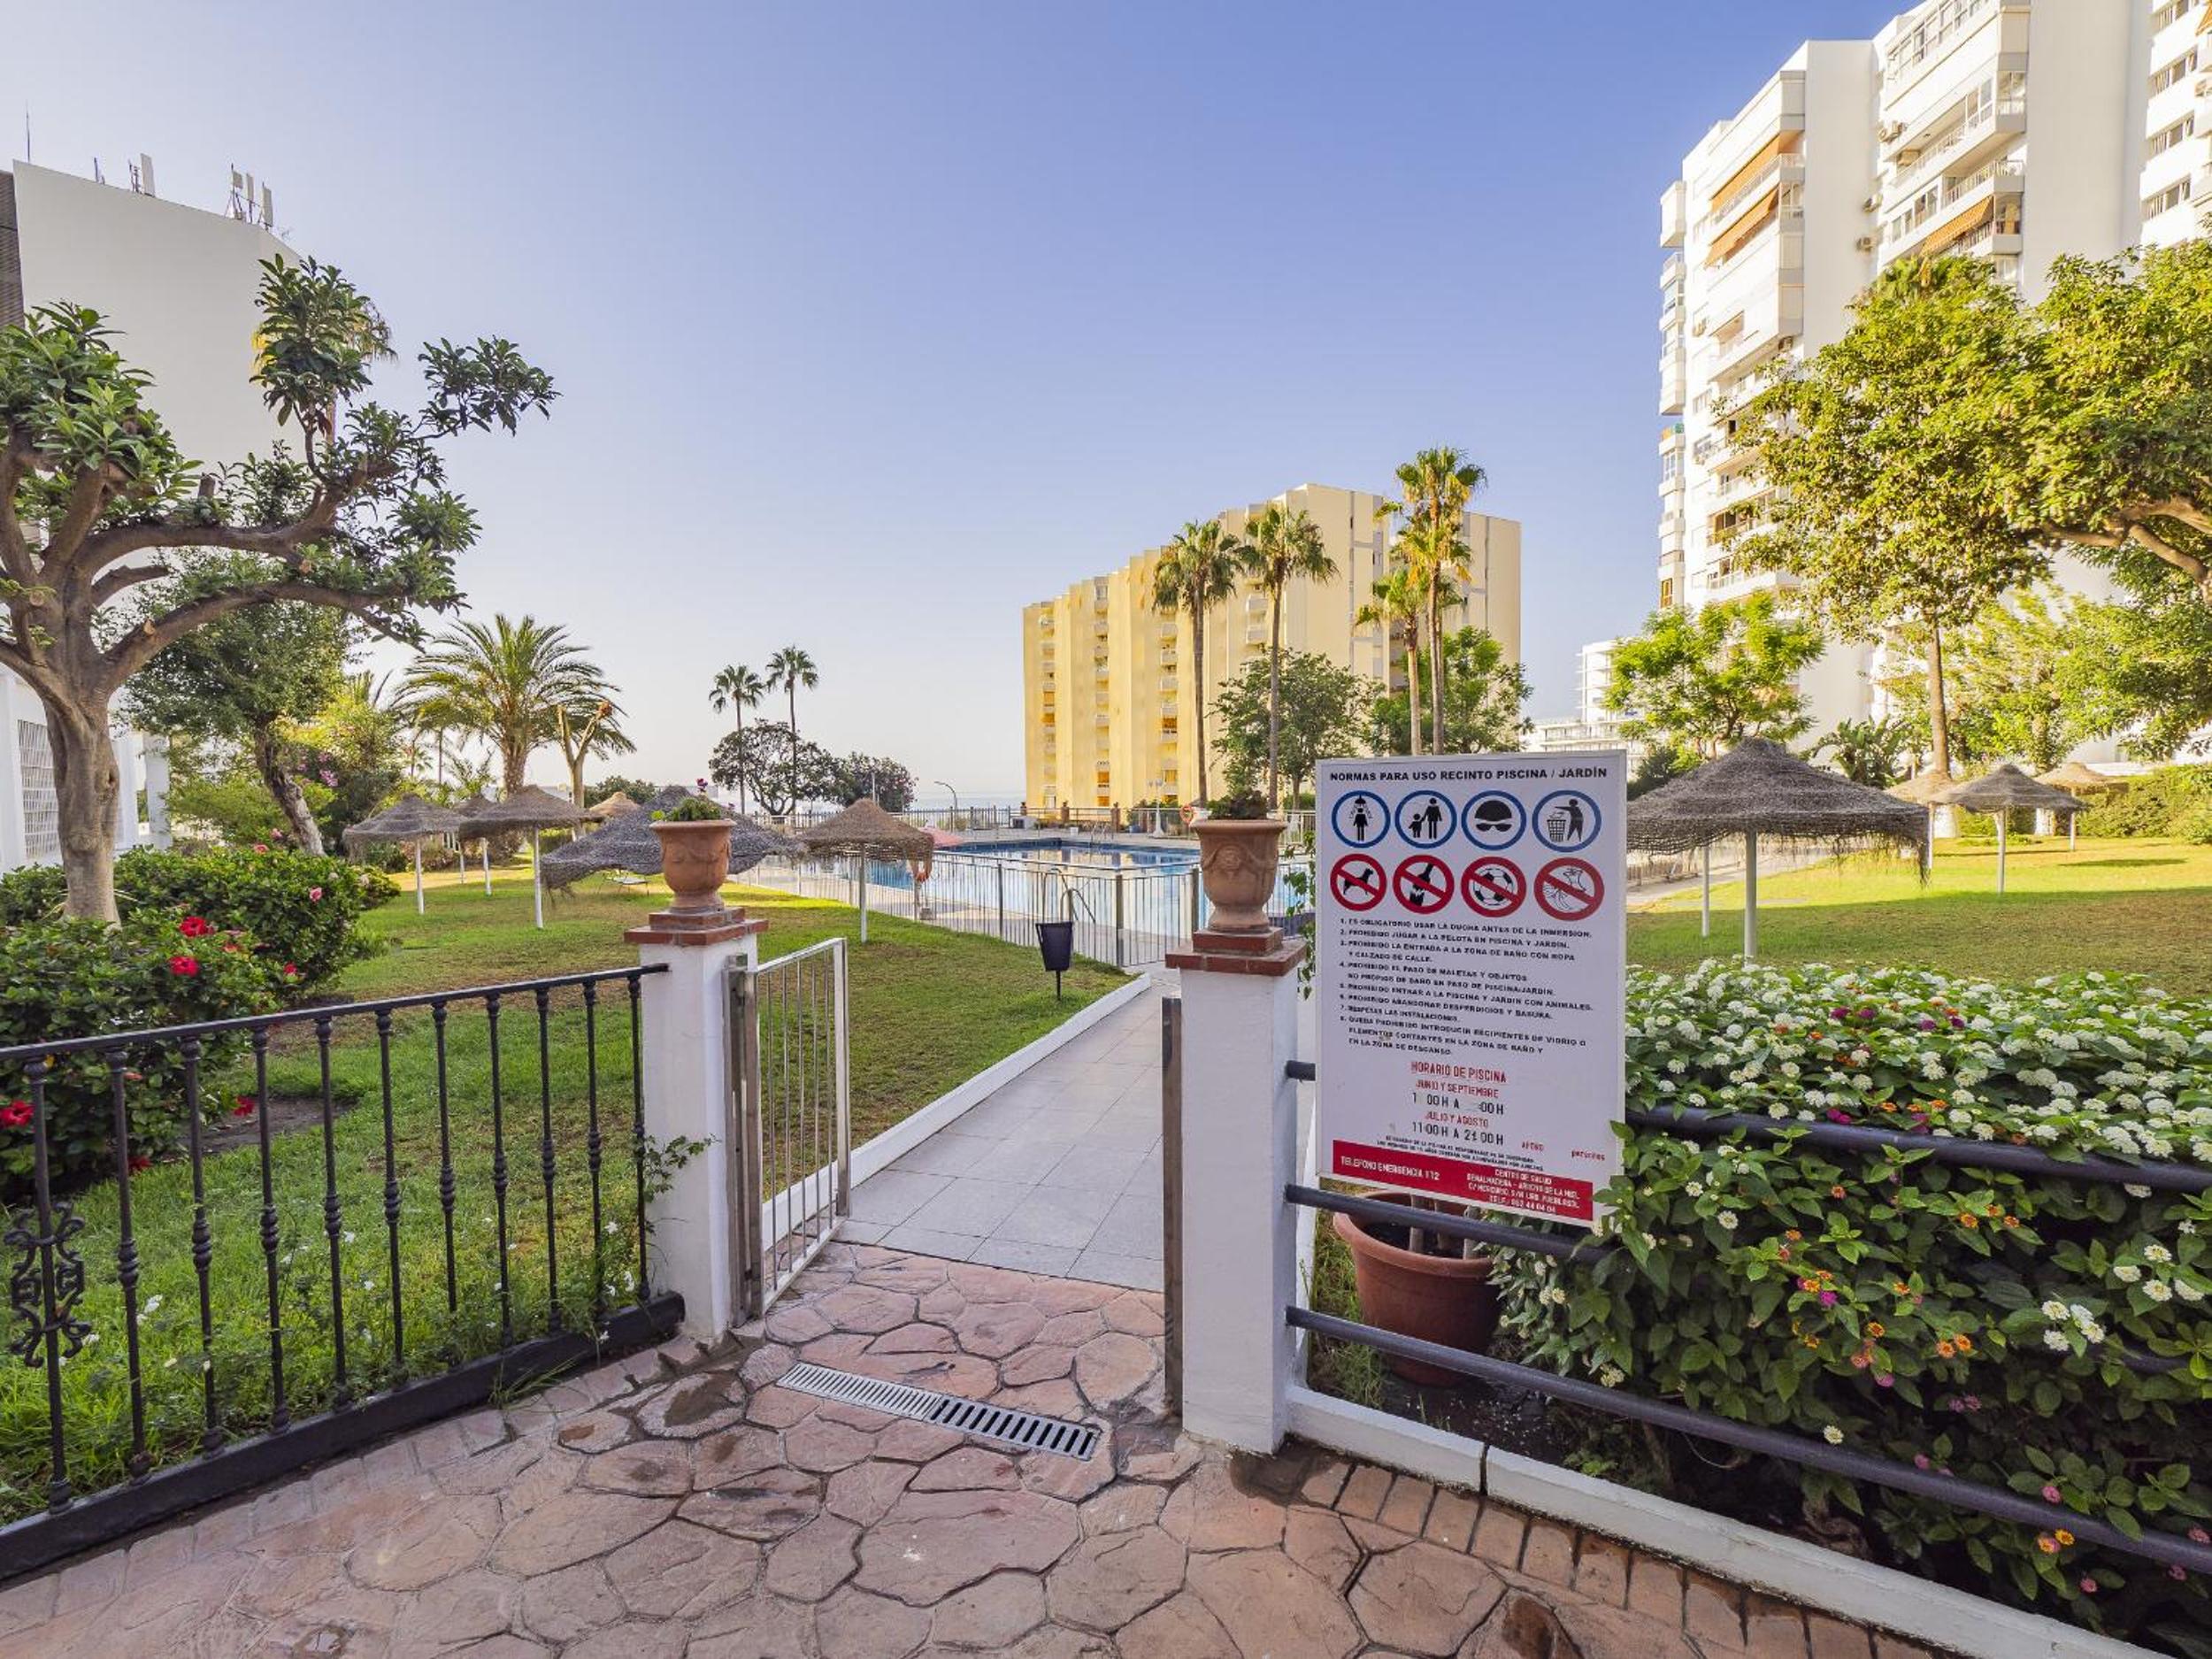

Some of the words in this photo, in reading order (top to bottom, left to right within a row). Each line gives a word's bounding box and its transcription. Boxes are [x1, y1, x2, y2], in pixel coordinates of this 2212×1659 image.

[1413, 771, 1437, 780] USO
[1440, 771, 1493, 780] RECINTO
[1496, 769, 1548, 780] PISCINA
[1559, 766, 1607, 778] JARDÍN
[1403, 942, 1441, 952] ENTRADA
[1488, 937, 1524, 946] PISCINA
[1348, 962, 1389, 971] PROHIBIDO
[1440, 969, 1478, 978] MALETAS
[1488, 972, 1527, 981] OBJETOS
[1348, 984, 1389, 993] PROHIBIDO
[1447, 992, 1480, 1001] PISCINA
[1348, 995, 1390, 1003] PROHIBIDO
[1392, 998, 1440, 1009] ABANDONAR
[1443, 1003, 1504, 1015] DESPERDICIOS
[1348, 1027, 1394, 1037] ELEMENTOS
[1396, 1032, 1443, 1043] CORTANTES
[1376, 1018, 1418, 1028] PROHIBIDO
[1421, 1023, 1471, 1034] INTRODUCIR
[1474, 1029, 1530, 1041] RECIPIENTES
[1546, 1036, 1578, 1047] VIDRIO
[1410, 1061, 1450, 1077] HORARIO
[1454, 1065, 1466, 1078] DE
[1469, 1068, 1507, 1083] PISCINA
[1417, 1080, 1439, 1091] JUNIO
[1448, 1084, 1500, 1099] SEPTIEMBRE
[1454, 1098, 1460, 1109] A
[1425, 1111, 1448, 1122] JULIO
[1457, 1117, 1489, 1129] AGOSTO
[1454, 1128, 1460, 1139] A
[1425, 1171, 1440, 1180] 112
[1531, 1174, 1552, 1186] SALUD
